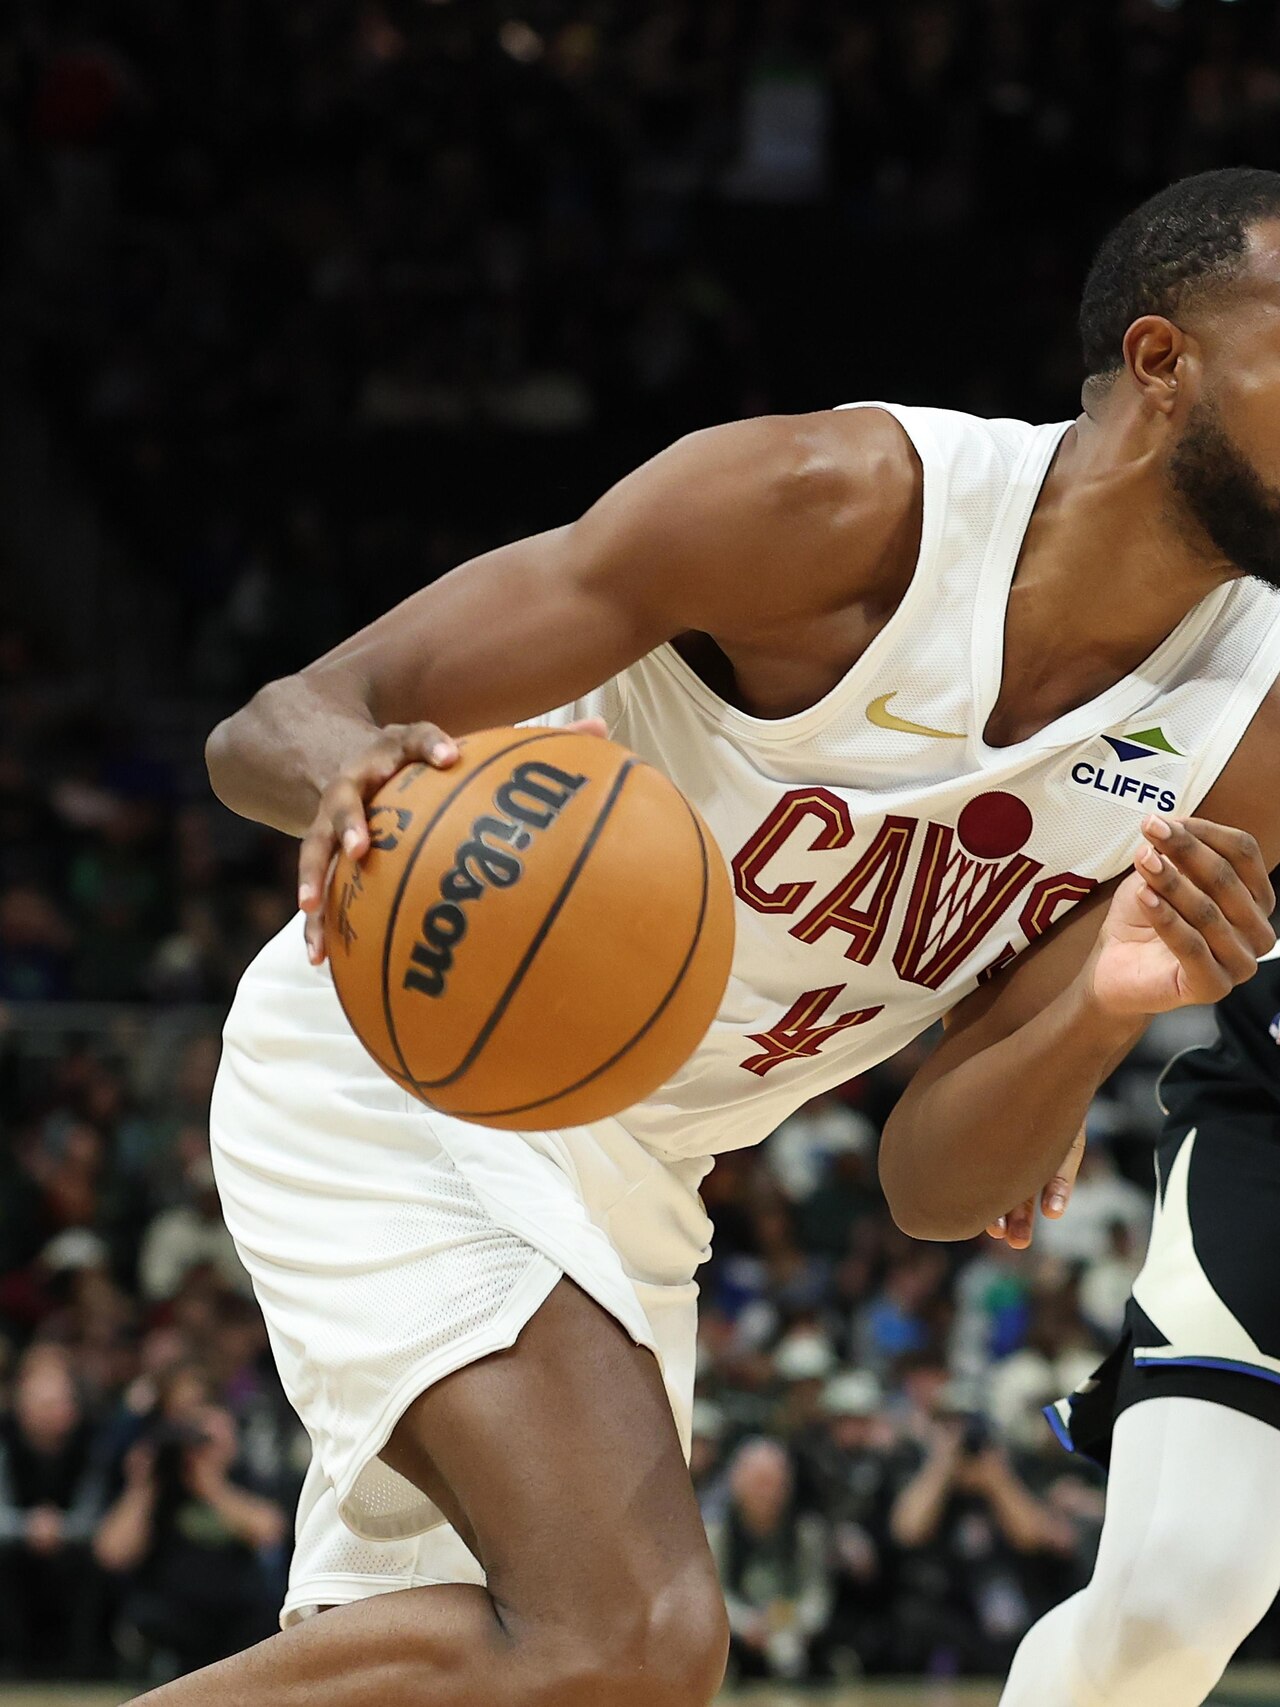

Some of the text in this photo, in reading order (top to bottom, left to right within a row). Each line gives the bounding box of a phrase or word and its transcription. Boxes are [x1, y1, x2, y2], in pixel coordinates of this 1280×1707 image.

[1072, 762, 1176, 812] CLIFFS
[403, 761, 592, 998] Wilson
[739, 983, 884, 1077] 4
